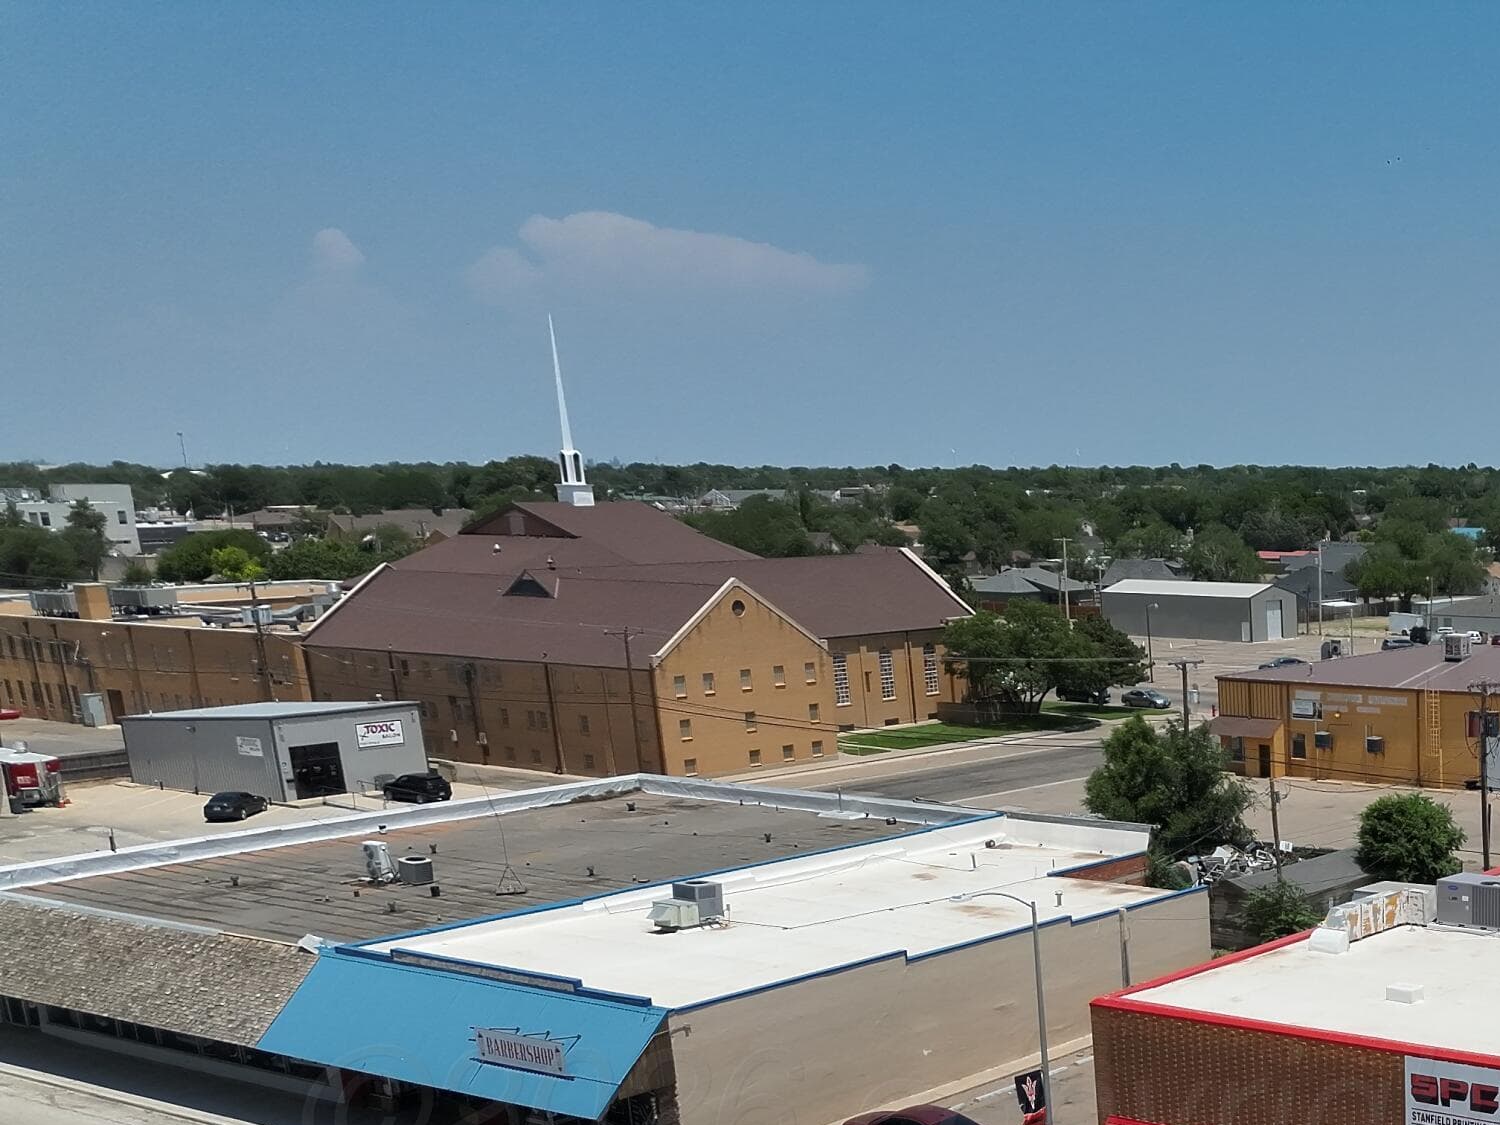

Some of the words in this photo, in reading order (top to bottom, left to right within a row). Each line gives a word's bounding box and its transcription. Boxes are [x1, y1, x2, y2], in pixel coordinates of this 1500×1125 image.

[363, 723, 395, 734] TOXIC
[486, 1037, 554, 1066] BARBERSHOP
[1411, 1073, 1499, 1114] SPC
